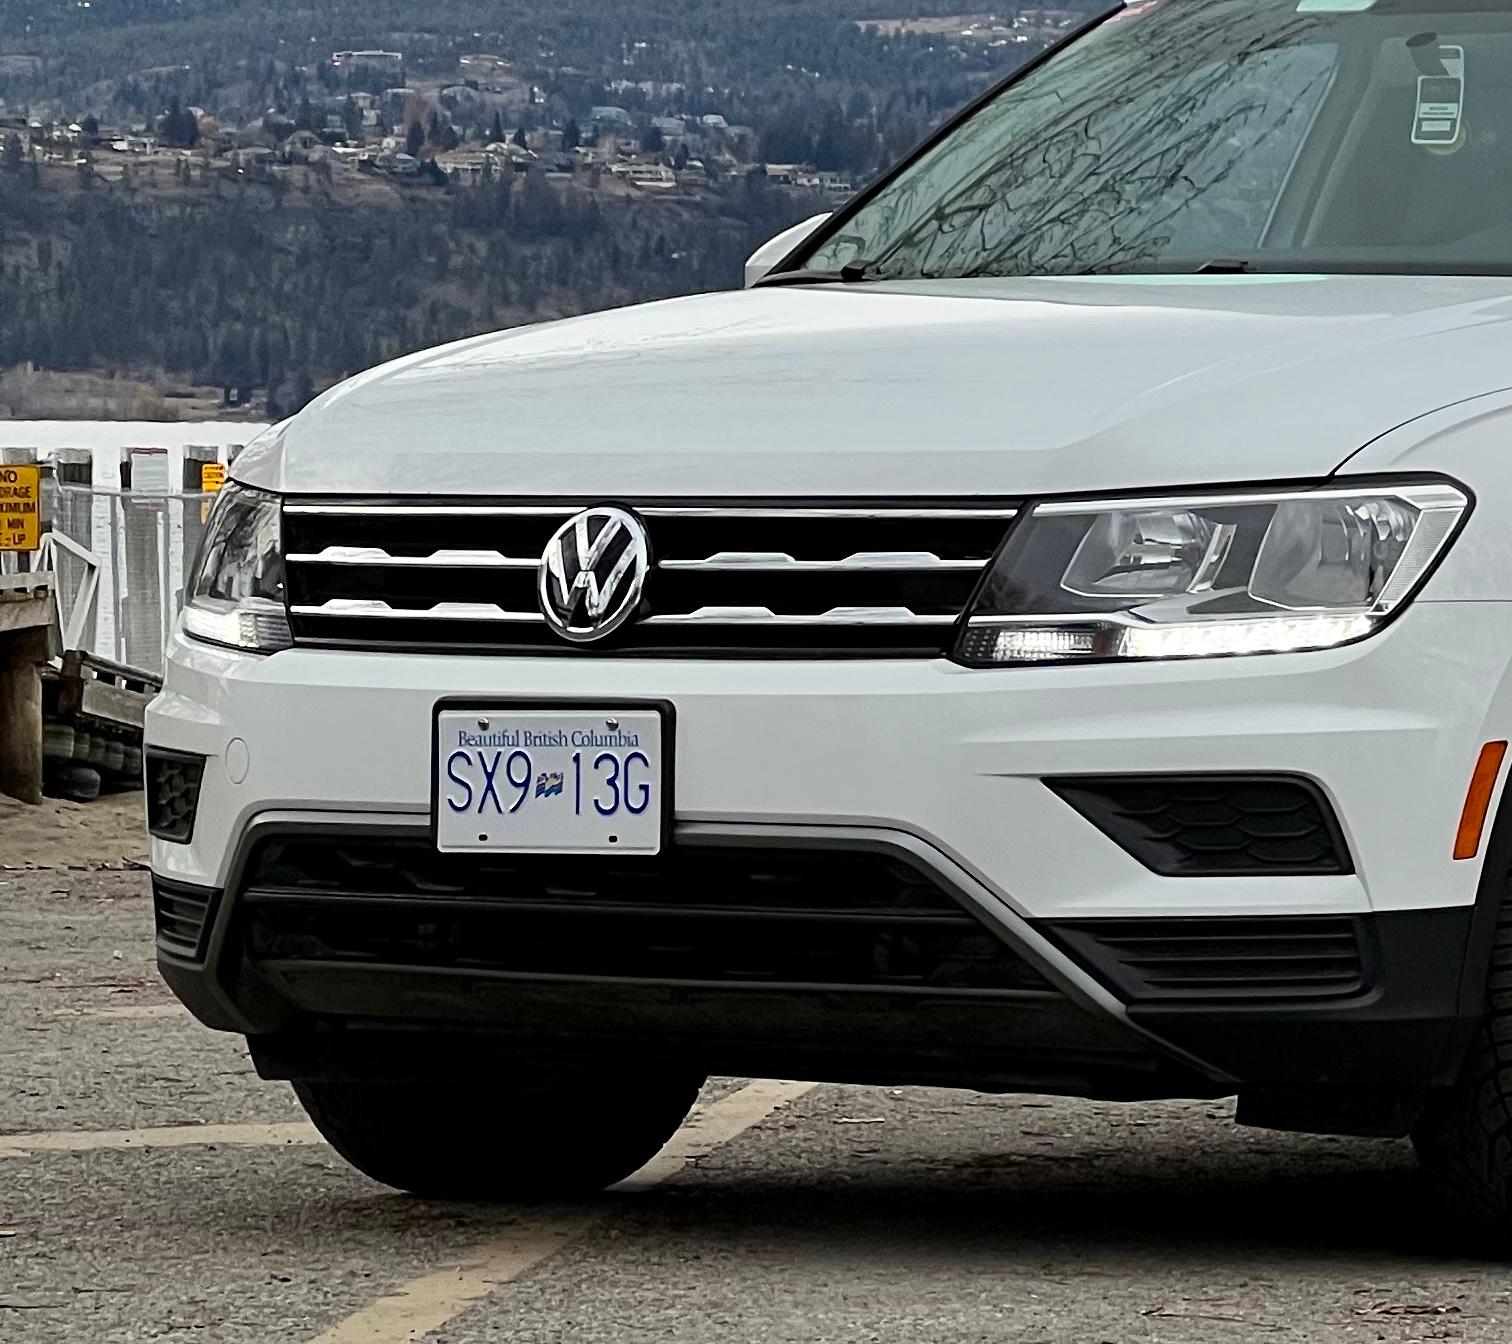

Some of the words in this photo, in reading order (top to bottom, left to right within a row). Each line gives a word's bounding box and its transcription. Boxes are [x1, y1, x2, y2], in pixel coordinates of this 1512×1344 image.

[458, 730, 520, 747] Beautiful
[523, 730, 568, 747] British
[571, 731, 640, 748] Columbia
[447, 750, 532, 815] SX9
[572, 751, 650, 816] 13G
